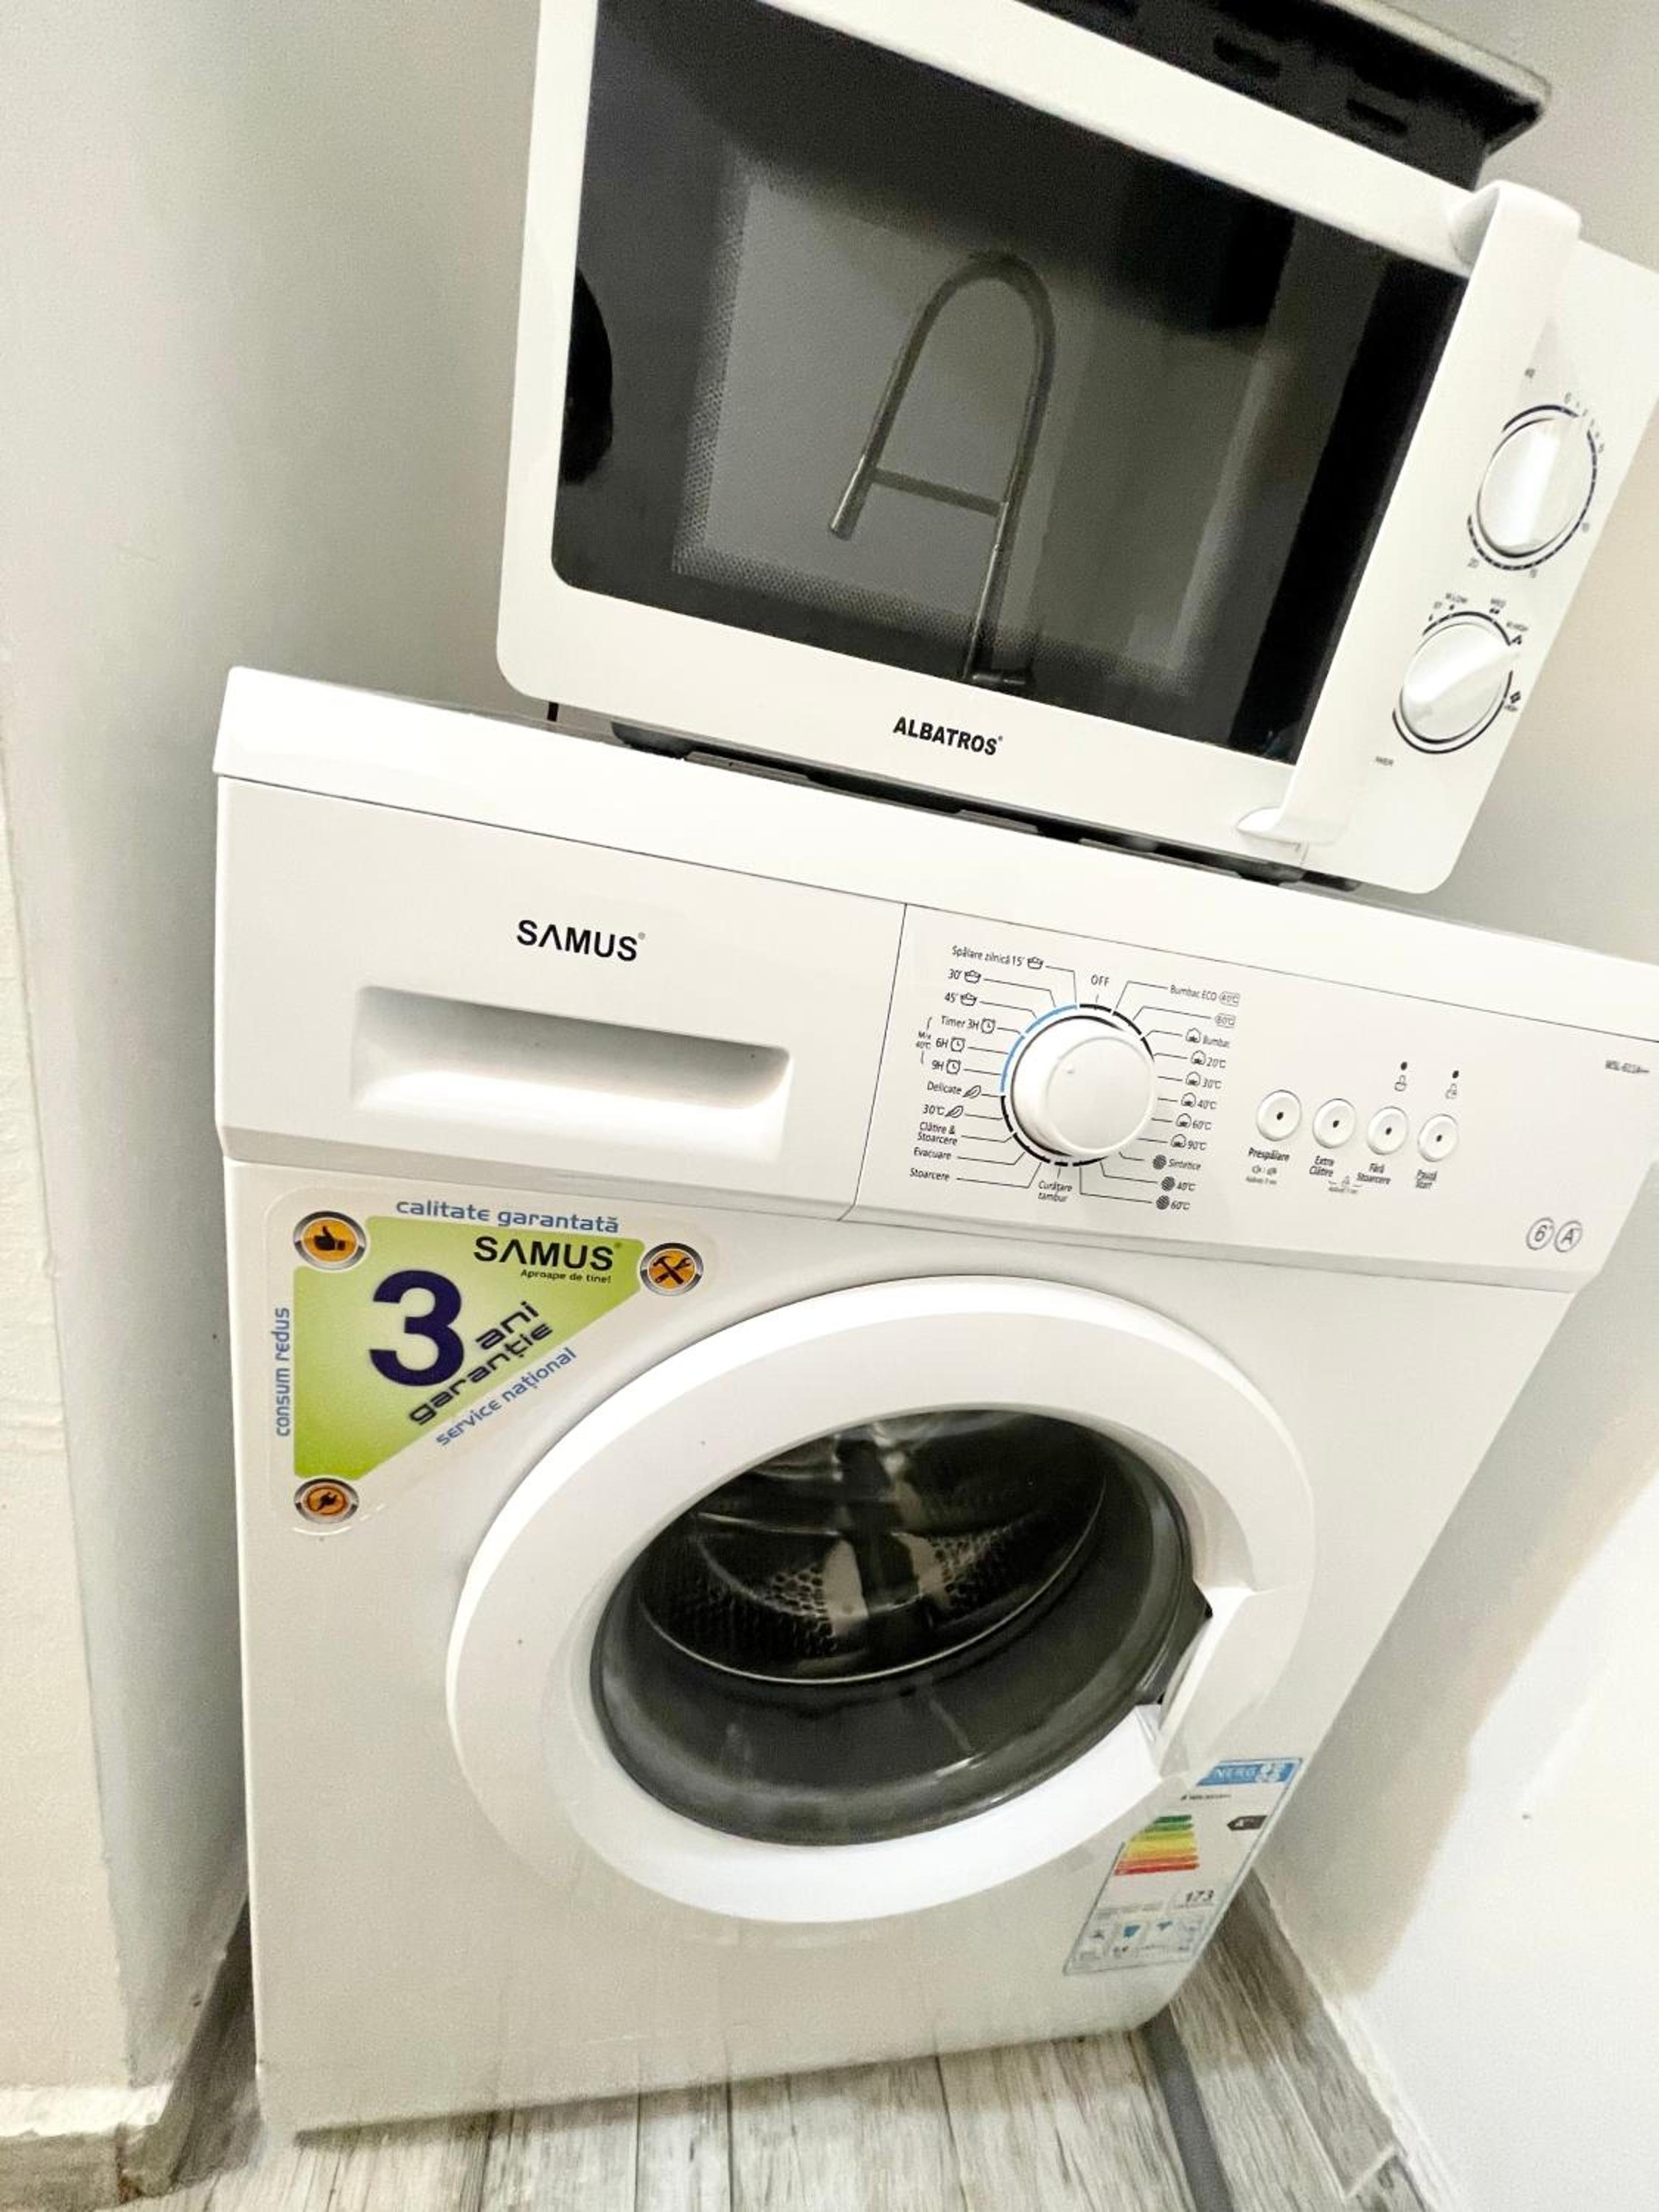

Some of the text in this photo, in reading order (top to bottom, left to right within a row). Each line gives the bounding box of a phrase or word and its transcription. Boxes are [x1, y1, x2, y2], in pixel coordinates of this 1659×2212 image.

[893, 716, 998, 756] ALBATROS
[1091, 975, 1109, 987] OFF
[1201, 990, 1217, 1001] ECO
[942, 1015, 980, 1030] Timer 3H
[936, 1037, 948, 1049] 6H
[931, 1060, 944, 1071] 9H
[927, 1081, 962, 1095] Delicate
[917, 1132, 958, 1146] Stoarcere
[914, 1147, 952, 1160] Evacuare
[1315, 1155, 1335, 1167] Extra
[909, 1167, 950, 1181] Stoarcere
[1037, 1192, 1068, 1202] tambur
[396, 1200, 620, 1234] calitate garantată
[520, 1269, 612, 1284] Aproape de tine!
[369, 1270, 465, 1387] 3
[475, 1301, 540, 1351] ani
[272, 1307, 291, 1437] consum redus
[408, 1323, 554, 1427] garanție
[435, 1347, 577, 1447] service național
